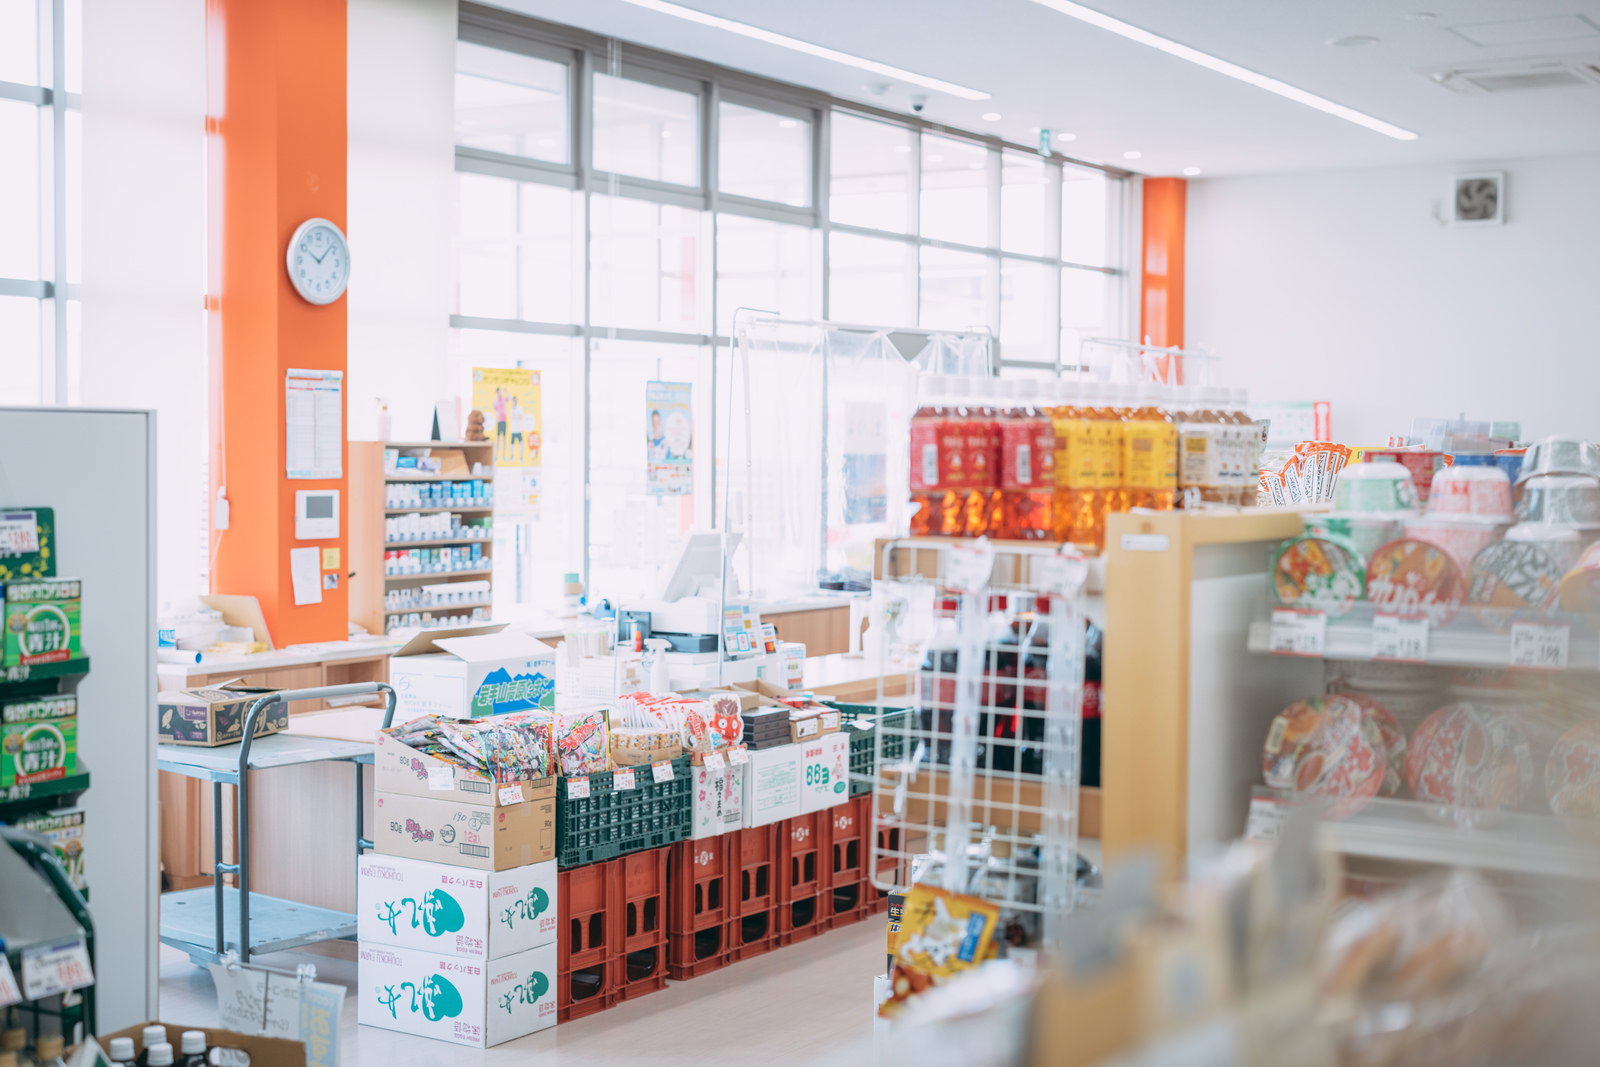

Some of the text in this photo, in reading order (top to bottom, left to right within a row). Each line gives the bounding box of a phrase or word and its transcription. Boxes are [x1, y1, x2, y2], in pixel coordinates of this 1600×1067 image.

[28, 632, 61, 651] 青汁
[24, 751, 57, 770] 青汁
[390, 821, 402, 834] 90g
